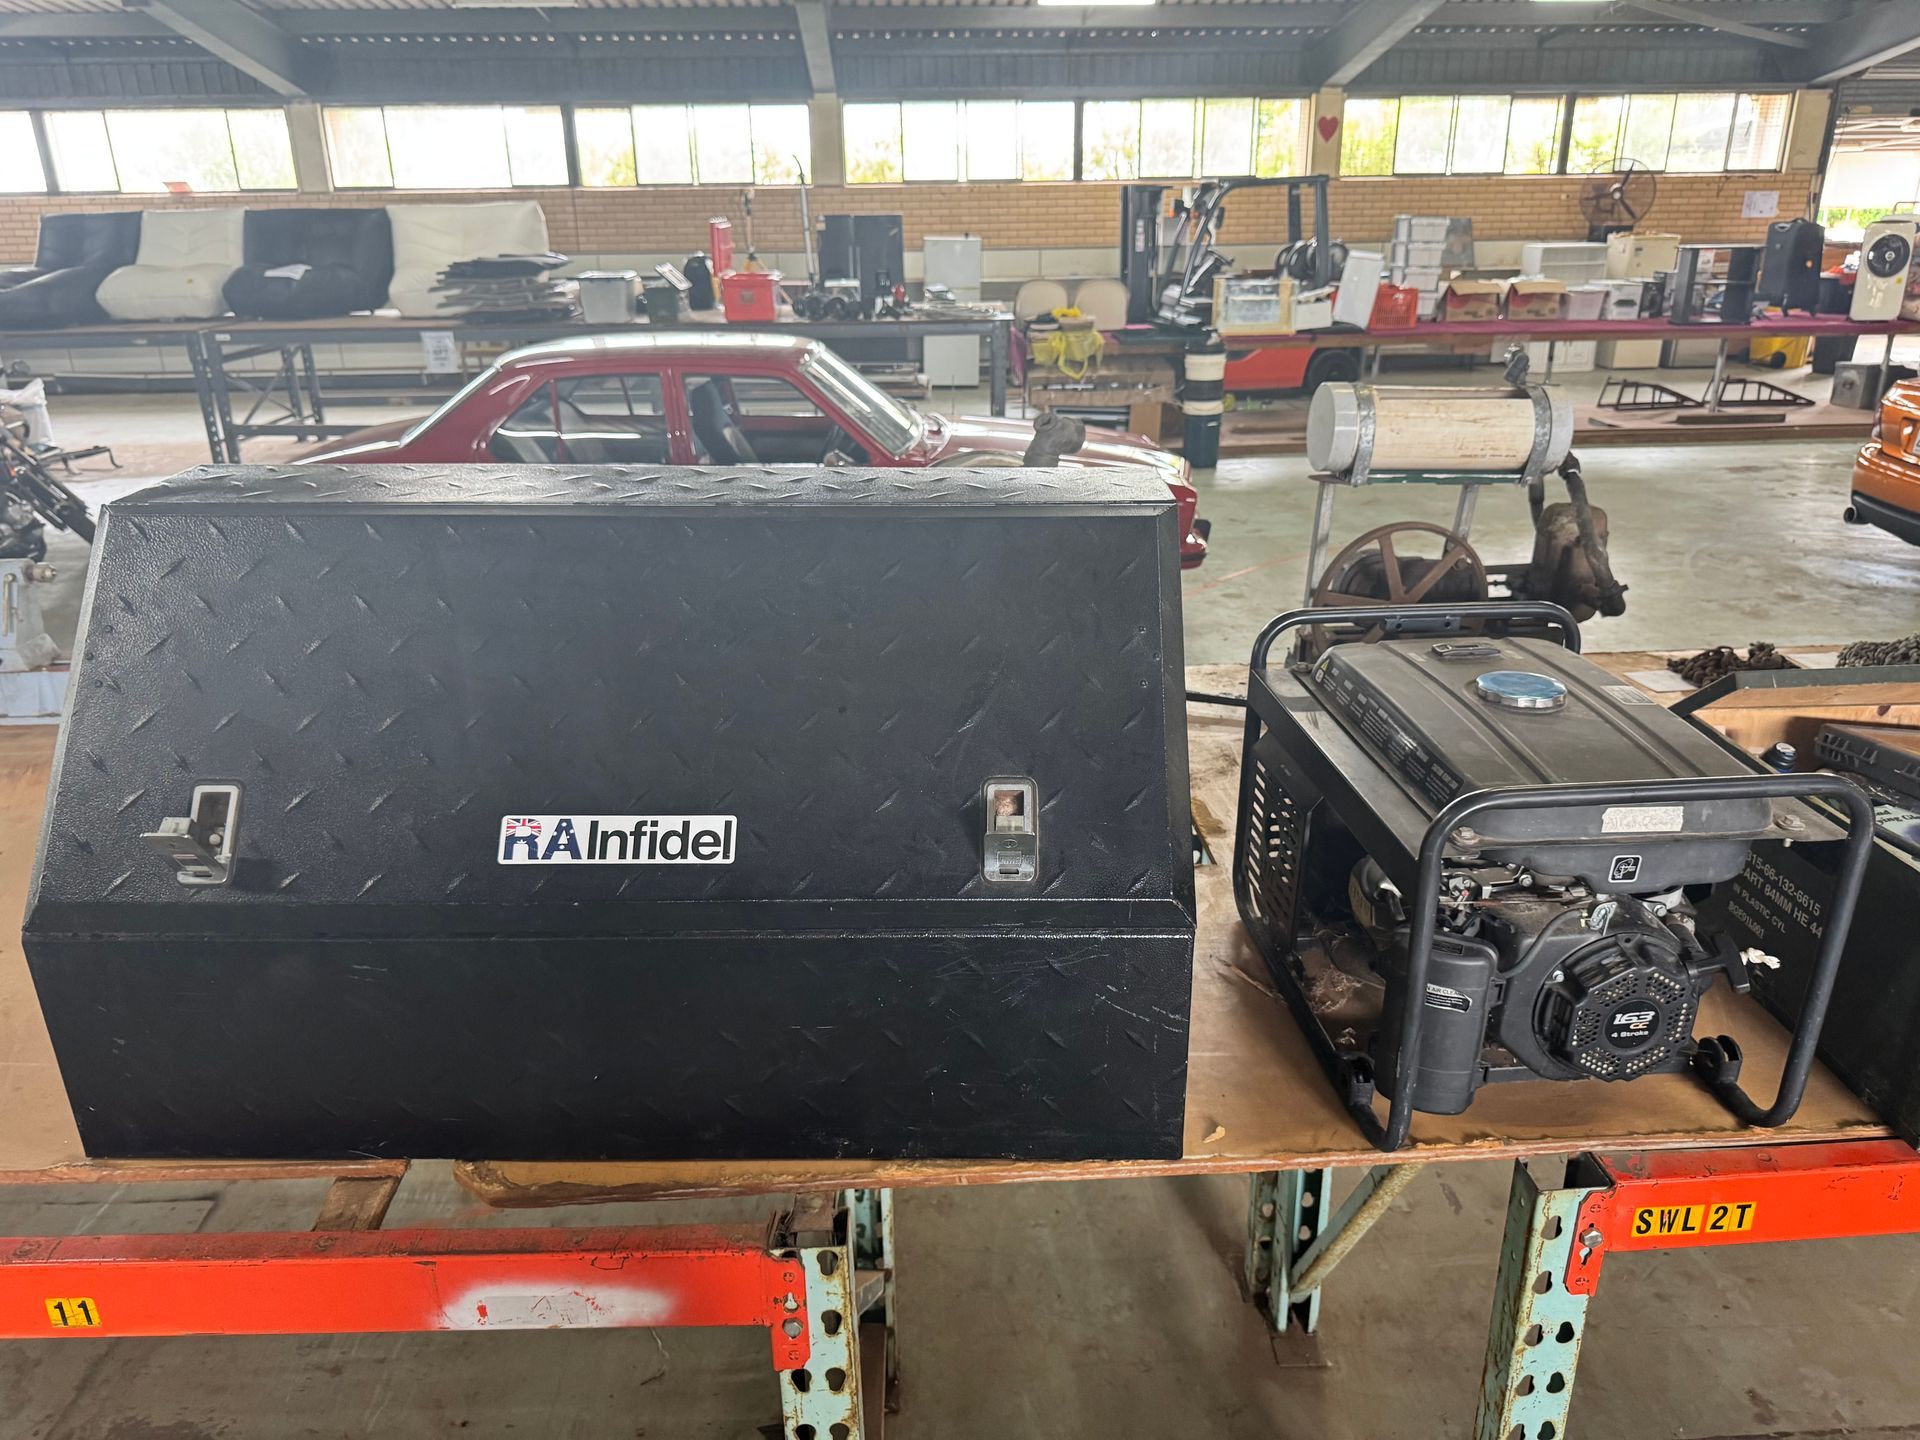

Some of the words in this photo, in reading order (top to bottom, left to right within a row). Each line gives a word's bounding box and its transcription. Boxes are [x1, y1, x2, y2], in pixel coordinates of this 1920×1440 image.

[587, 820, 733, 860] Infidel
[1742, 867, 1764, 889] ART
[1764, 884, 1793, 914] 84MM
[1793, 907, 1809, 928] HE
[1745, 850, 1821, 917] 315-66-132-6615
[1741, 890, 1770, 919] PLASTIC
[1771, 916, 1786, 934] CYL
[1613, 1011, 1656, 1025] 163
[1635, 1207, 1696, 1234] SWL
[1710, 1204, 1752, 1230] 2T
[54, 1300, 93, 1326] 11
